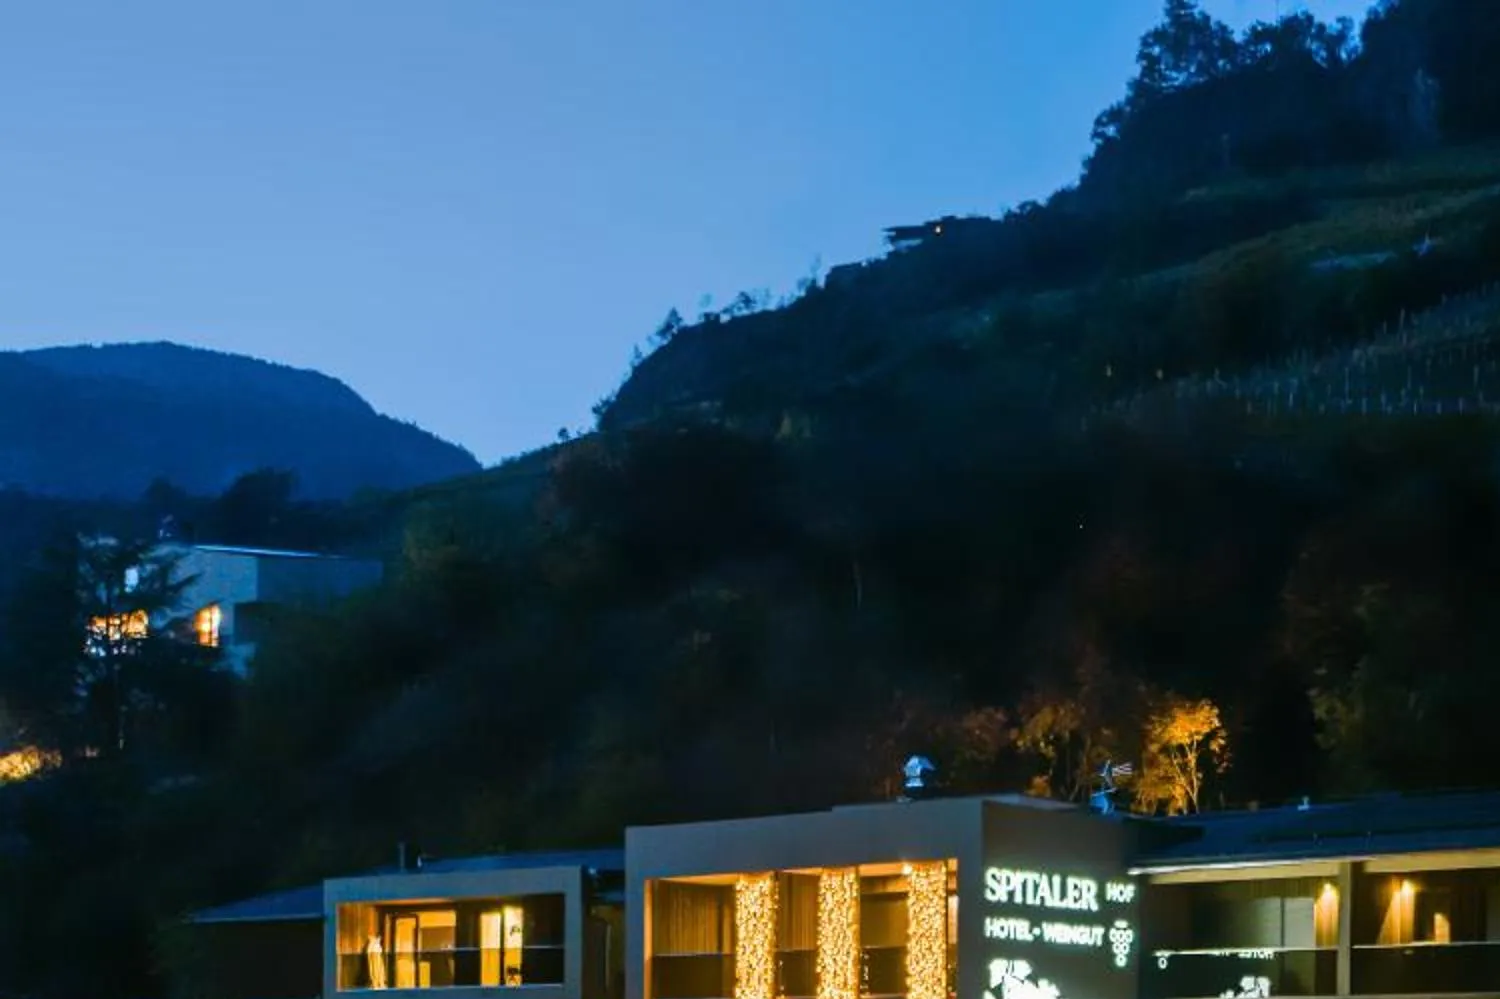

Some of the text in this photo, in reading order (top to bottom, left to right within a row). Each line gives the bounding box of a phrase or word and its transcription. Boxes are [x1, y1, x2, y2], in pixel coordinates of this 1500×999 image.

[984, 867, 1136, 912] SPITALER HOF
[984, 917, 1105, 947] HOTEL WEINGUT
